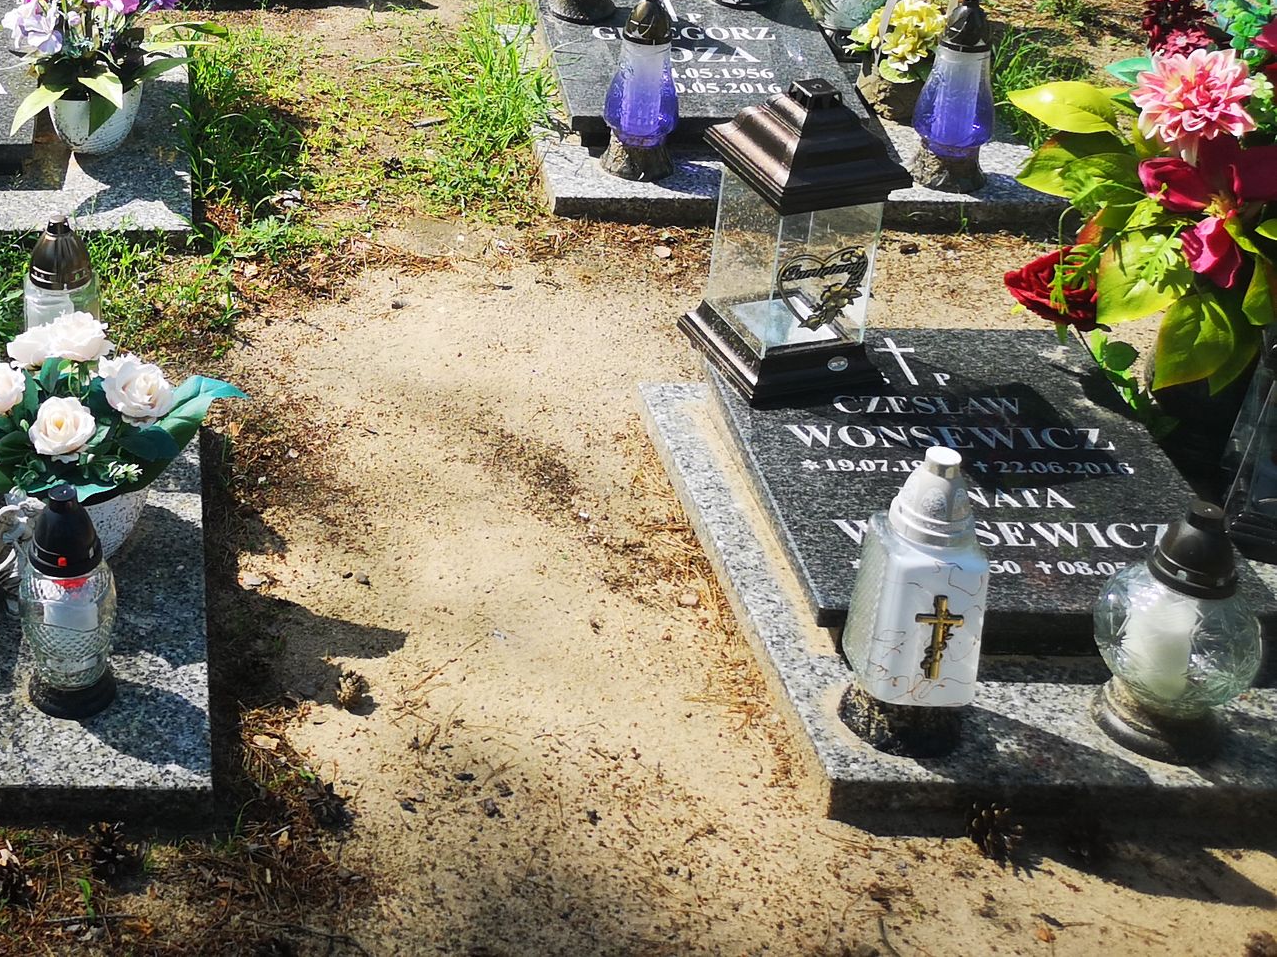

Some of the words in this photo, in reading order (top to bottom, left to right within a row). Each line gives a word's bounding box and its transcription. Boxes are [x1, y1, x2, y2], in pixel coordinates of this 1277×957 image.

[592, 26, 776, 41] GGORZ
[671, 67, 775, 79] 4.05.1956
[674, 82, 782, 94] 0.05.2016
[933, 372, 950, 386] P
[833, 394, 1019, 416] CZESŁAW
[783, 425, 1117, 451] WONSEWICZ
[994, 460, 1135, 475] 22.06.2016
[923, 486, 1076, 508] NATA
